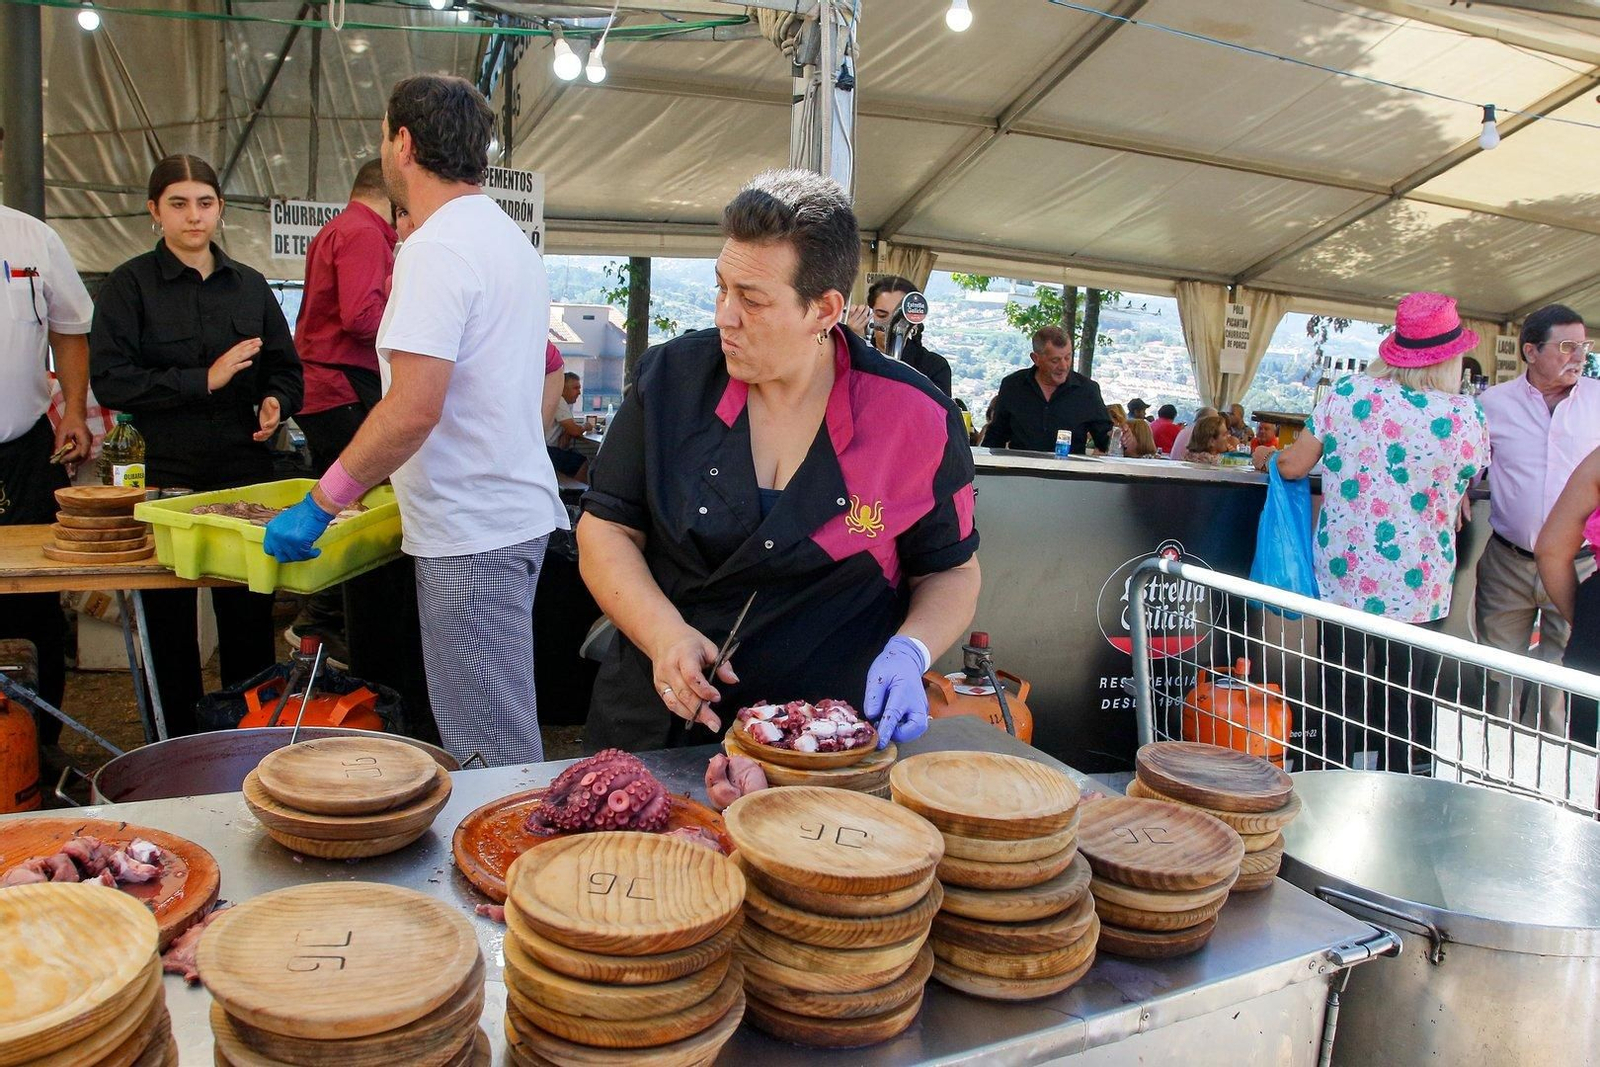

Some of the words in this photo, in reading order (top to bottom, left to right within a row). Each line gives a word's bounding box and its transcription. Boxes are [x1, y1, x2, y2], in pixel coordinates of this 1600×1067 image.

[483, 167, 533, 193] PEMENTOS
[274, 203, 346, 227] CHURRAS
[275, 234, 290, 255] DE
[1099, 675, 1196, 689] RESENCIA
